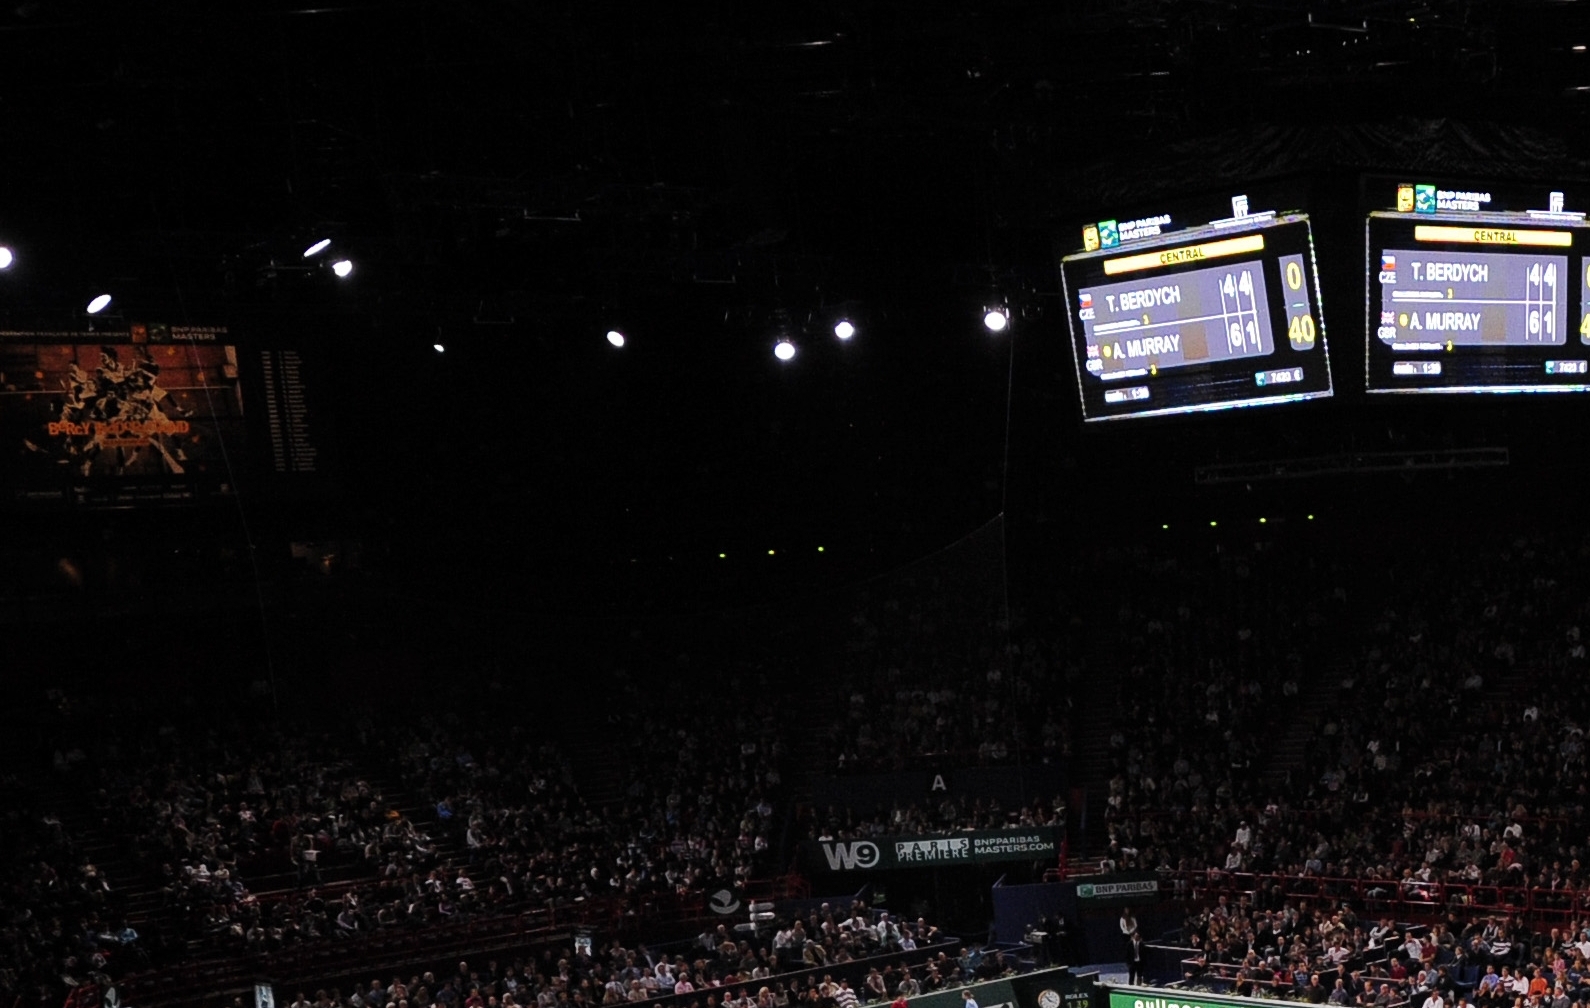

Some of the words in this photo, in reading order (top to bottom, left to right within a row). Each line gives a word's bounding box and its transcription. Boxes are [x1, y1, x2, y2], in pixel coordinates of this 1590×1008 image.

[1474, 230, 1517, 242] CENTRAL
[1159, 248, 1204, 264] CENTRAL
[1286, 261, 1301, 291] 0
[1379, 272, 1396, 284] CZE
[1411, 262, 1424, 281] T.
[1426, 263, 1488, 282] BERDYCH
[1106, 295, 1119, 313] T.
[1119, 285, 1181, 310] BERDYCH
[1079, 308, 1095, 320] CZE
[1410, 313, 1423, 330] A.
[1426, 313, 1481, 331] MURRAY
[1289, 315, 1315, 344] 40
[1377, 327, 1396, 339] GBR
[171, 333, 216, 341] MASTERS
[1113, 342, 1126, 360] A.
[1126, 334, 1180, 358] MURRAY
[1086, 359, 1103, 372] GBR
[931, 774, 947, 791] A
[897, 839, 969, 852] PARIS
[974, 835, 1040, 846] BNPPARIBAS
[974, 843, 1054, 854] MASTERS.COM
[822, 841, 880, 870] W9
[1095, 885, 1114, 894] BNP
[1116, 881, 1154, 892] PARIBAS
